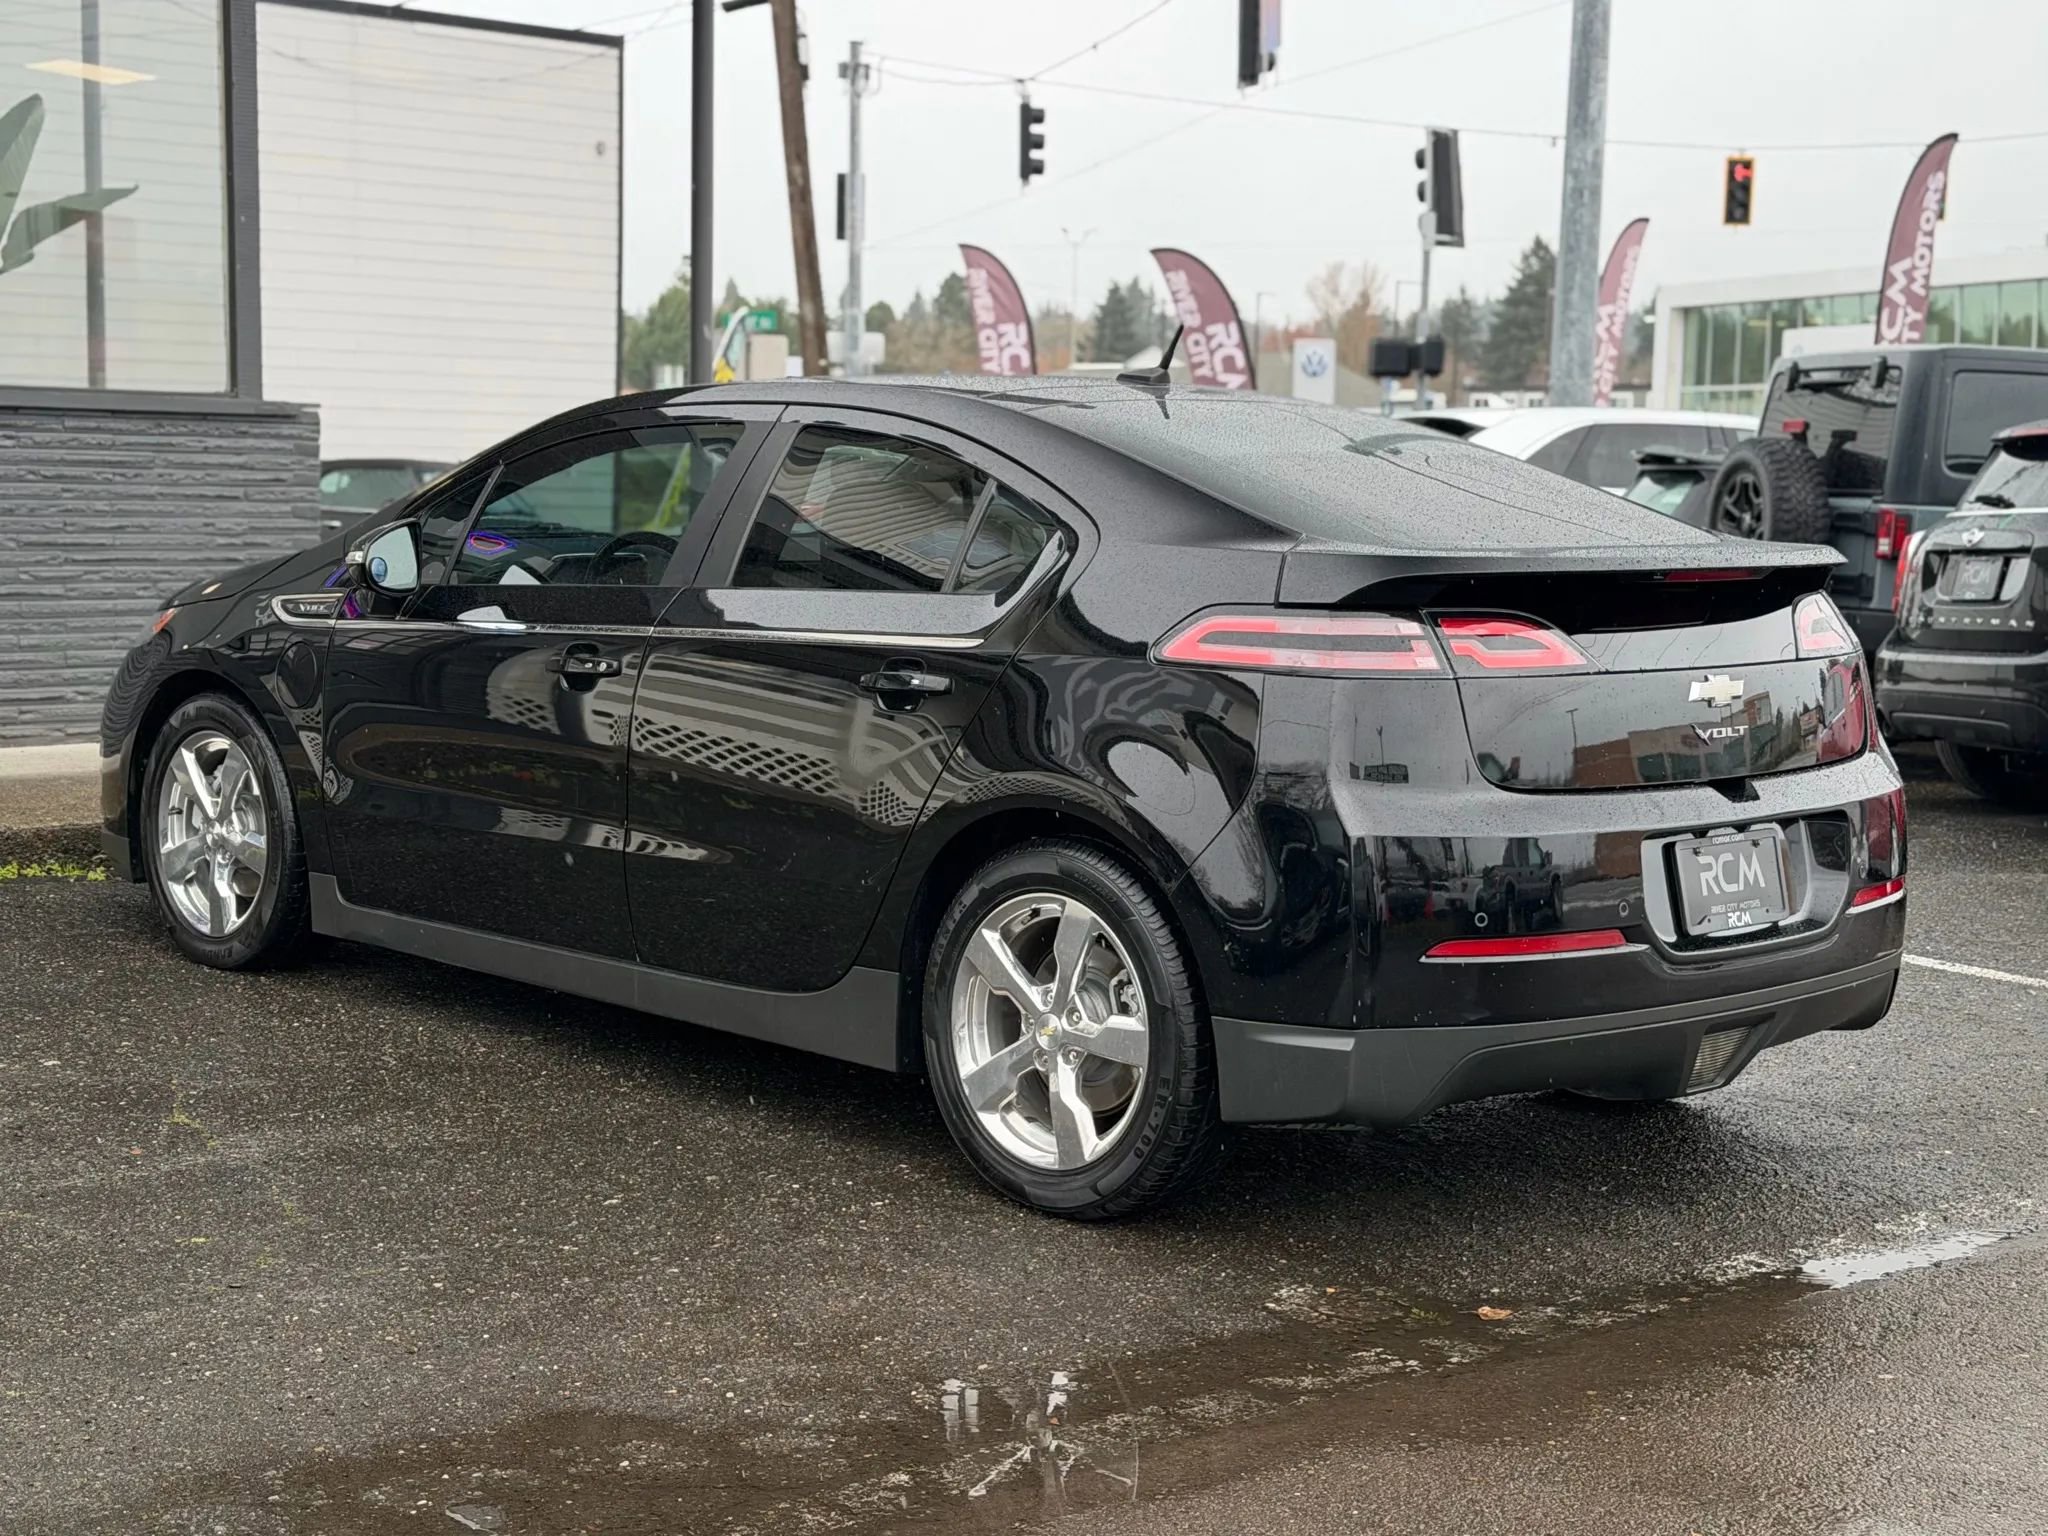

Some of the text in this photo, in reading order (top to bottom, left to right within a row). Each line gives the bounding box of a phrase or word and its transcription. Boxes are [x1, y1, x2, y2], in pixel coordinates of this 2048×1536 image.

[1901, 169, 1946, 344] TY MOTORS
[1165, 269, 1215, 378] RIVER CITY
[1880, 256, 1914, 345] CM
[978, 327, 1001, 374] CITY
[998, 321, 1031, 376] RC
[1962, 563, 1992, 584] RCM
[1690, 723, 1749, 746] VOLT
[1696, 850, 1766, 897] RCM
[1710, 898, 1761, 914] RIVER CITY MOTORS
[1727, 911, 1752, 928] RCM
